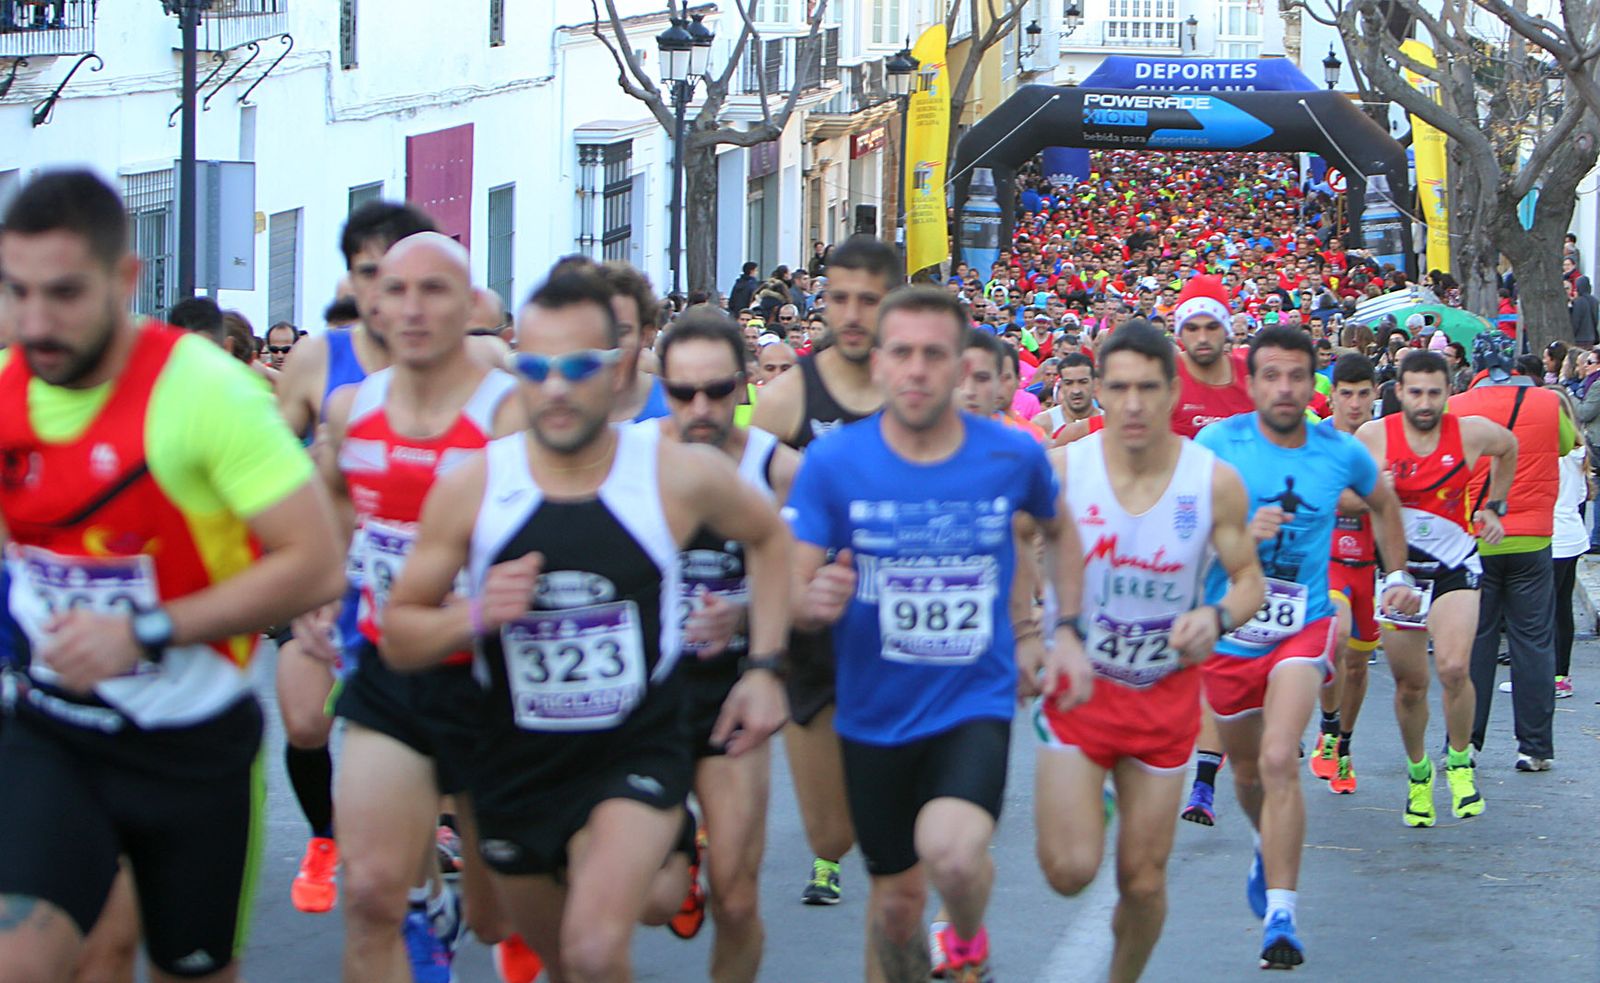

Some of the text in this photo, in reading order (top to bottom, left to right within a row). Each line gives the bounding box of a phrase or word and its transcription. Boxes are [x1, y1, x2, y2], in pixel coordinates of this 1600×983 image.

[1135, 62, 1258, 80] DEPORTES
[1083, 93, 1213, 110] POWERADE
[1083, 131, 1209, 146] bebida para deportistas
[1094, 567, 1184, 607] JEREZ
[894, 600, 979, 631] 982
[523, 638, 625, 684] 323
[1096, 632, 1169, 664] 472
